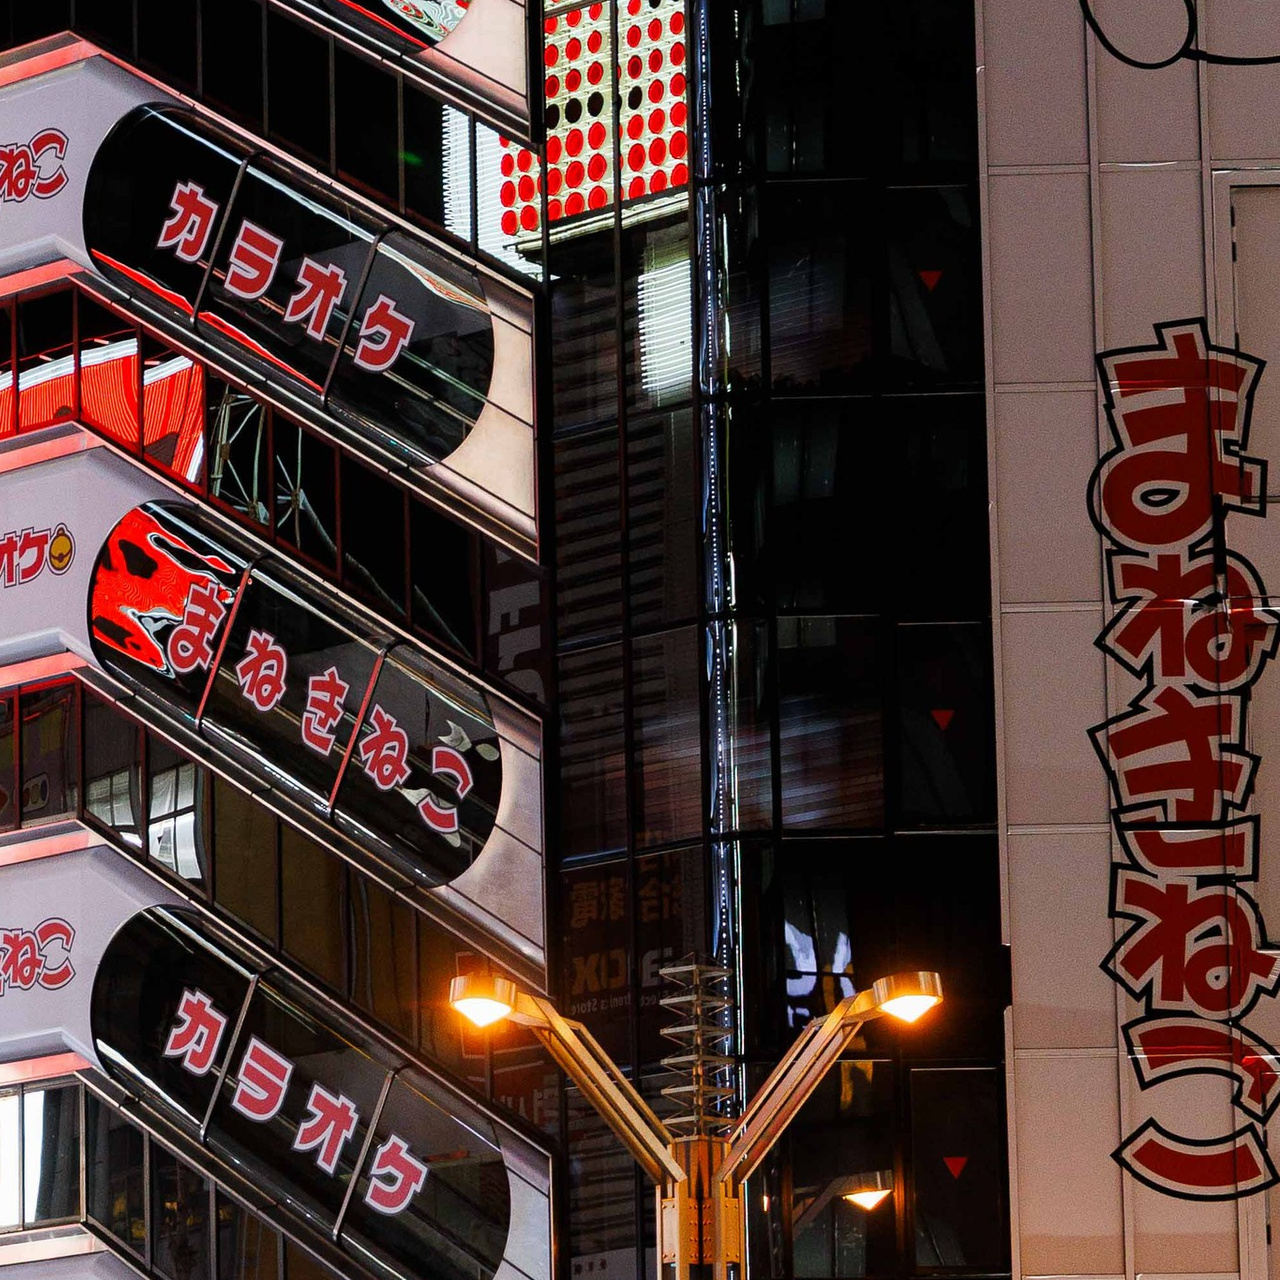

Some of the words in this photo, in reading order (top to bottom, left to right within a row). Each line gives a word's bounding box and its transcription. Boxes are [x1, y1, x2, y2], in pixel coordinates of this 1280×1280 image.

[157, 179, 416, 373] カラオケ
[168, 582, 477, 834] まねきねこ
[1087, 317, 1280, 1201] まねきねこ
[163, 988, 430, 1216] カラオケ
